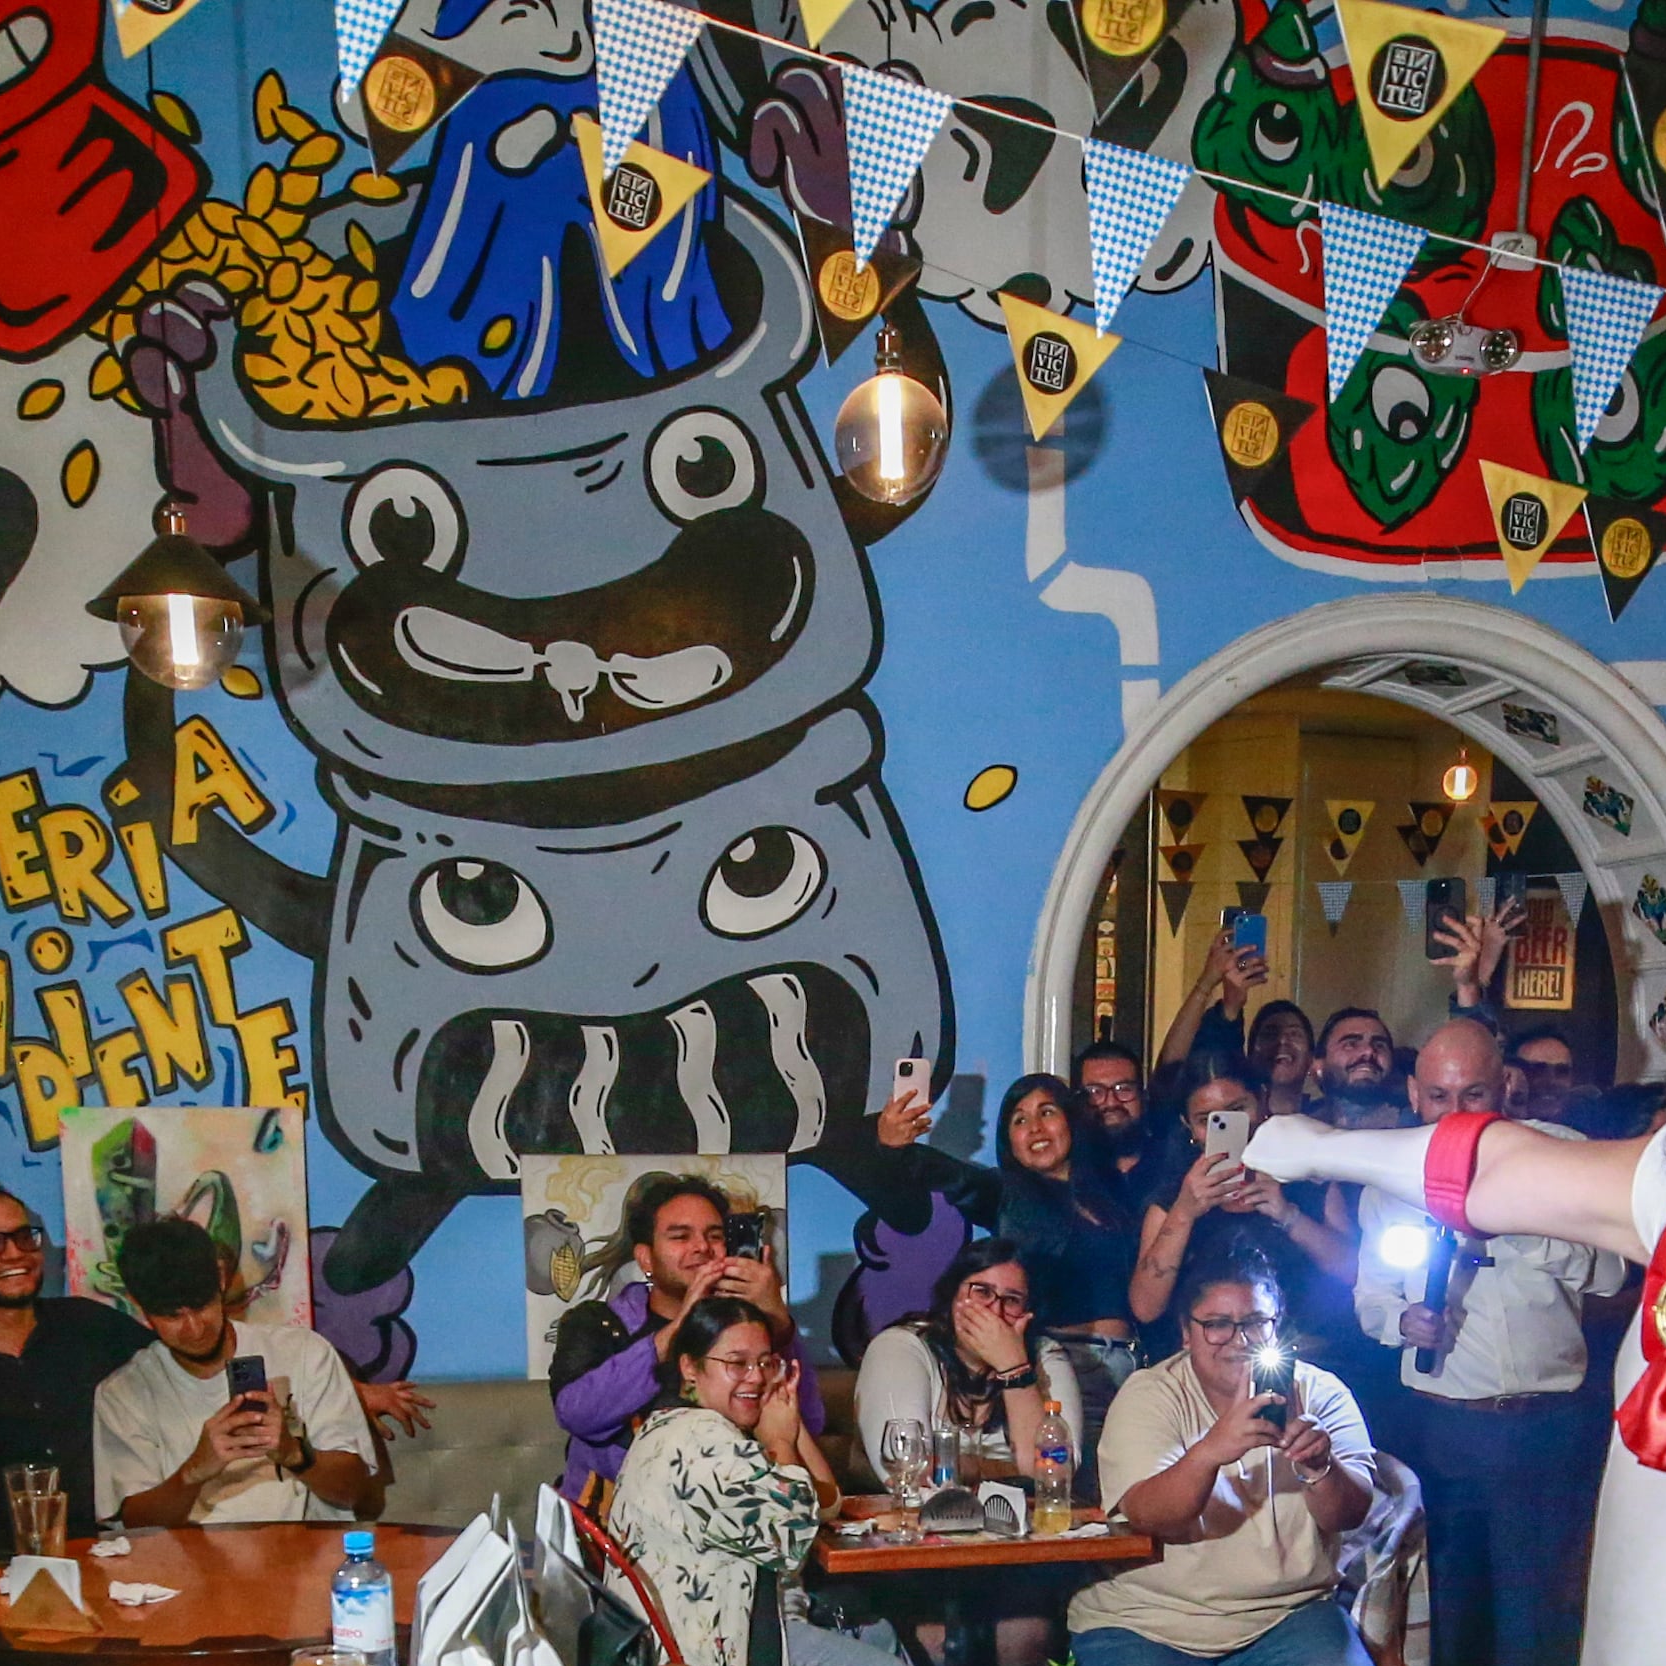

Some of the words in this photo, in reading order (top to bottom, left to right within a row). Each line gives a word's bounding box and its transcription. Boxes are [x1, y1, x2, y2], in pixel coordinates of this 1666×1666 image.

[1391, 65, 1426, 88] VIC
[1386, 84, 1422, 107] TUS
[618, 184, 646, 207] VIC
[614, 199, 643, 221] TUS
[1037, 353, 1062, 372] VIC
[1034, 366, 1060, 385] TUS
[1513, 513, 1535, 529] VIC
[1512, 526, 1534, 541] TUS
[1518, 969, 1561, 998] HERE!
